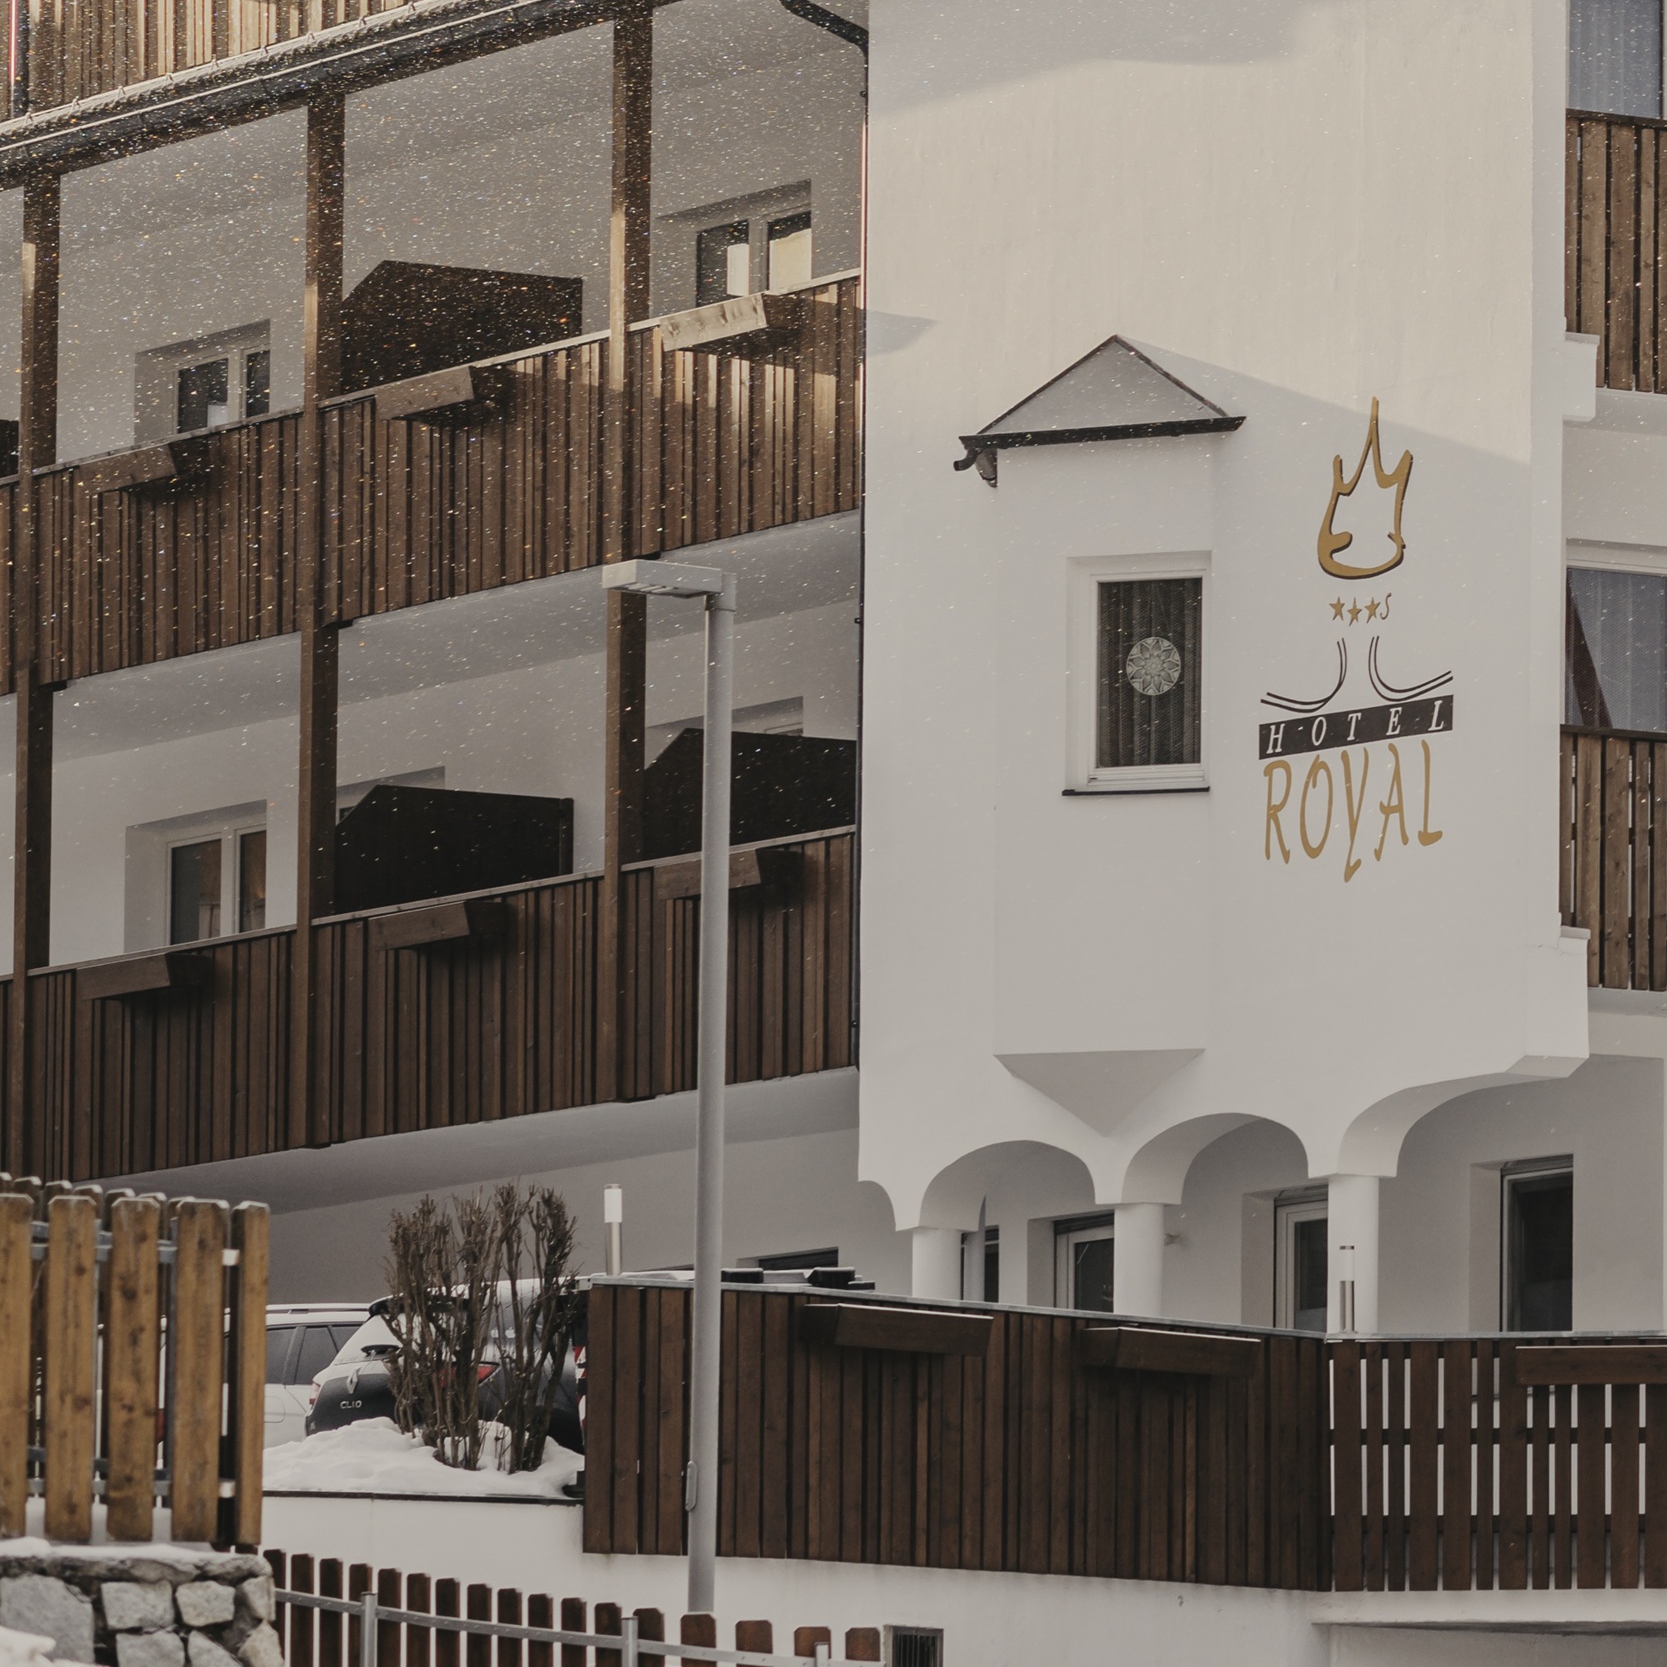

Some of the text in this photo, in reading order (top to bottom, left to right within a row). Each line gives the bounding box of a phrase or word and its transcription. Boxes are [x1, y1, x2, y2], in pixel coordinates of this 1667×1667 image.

[1265, 700, 1446, 755] HOTEL
[1263, 739, 1443, 883] ROYAL
[340, 1400, 362, 1409] CLIO
